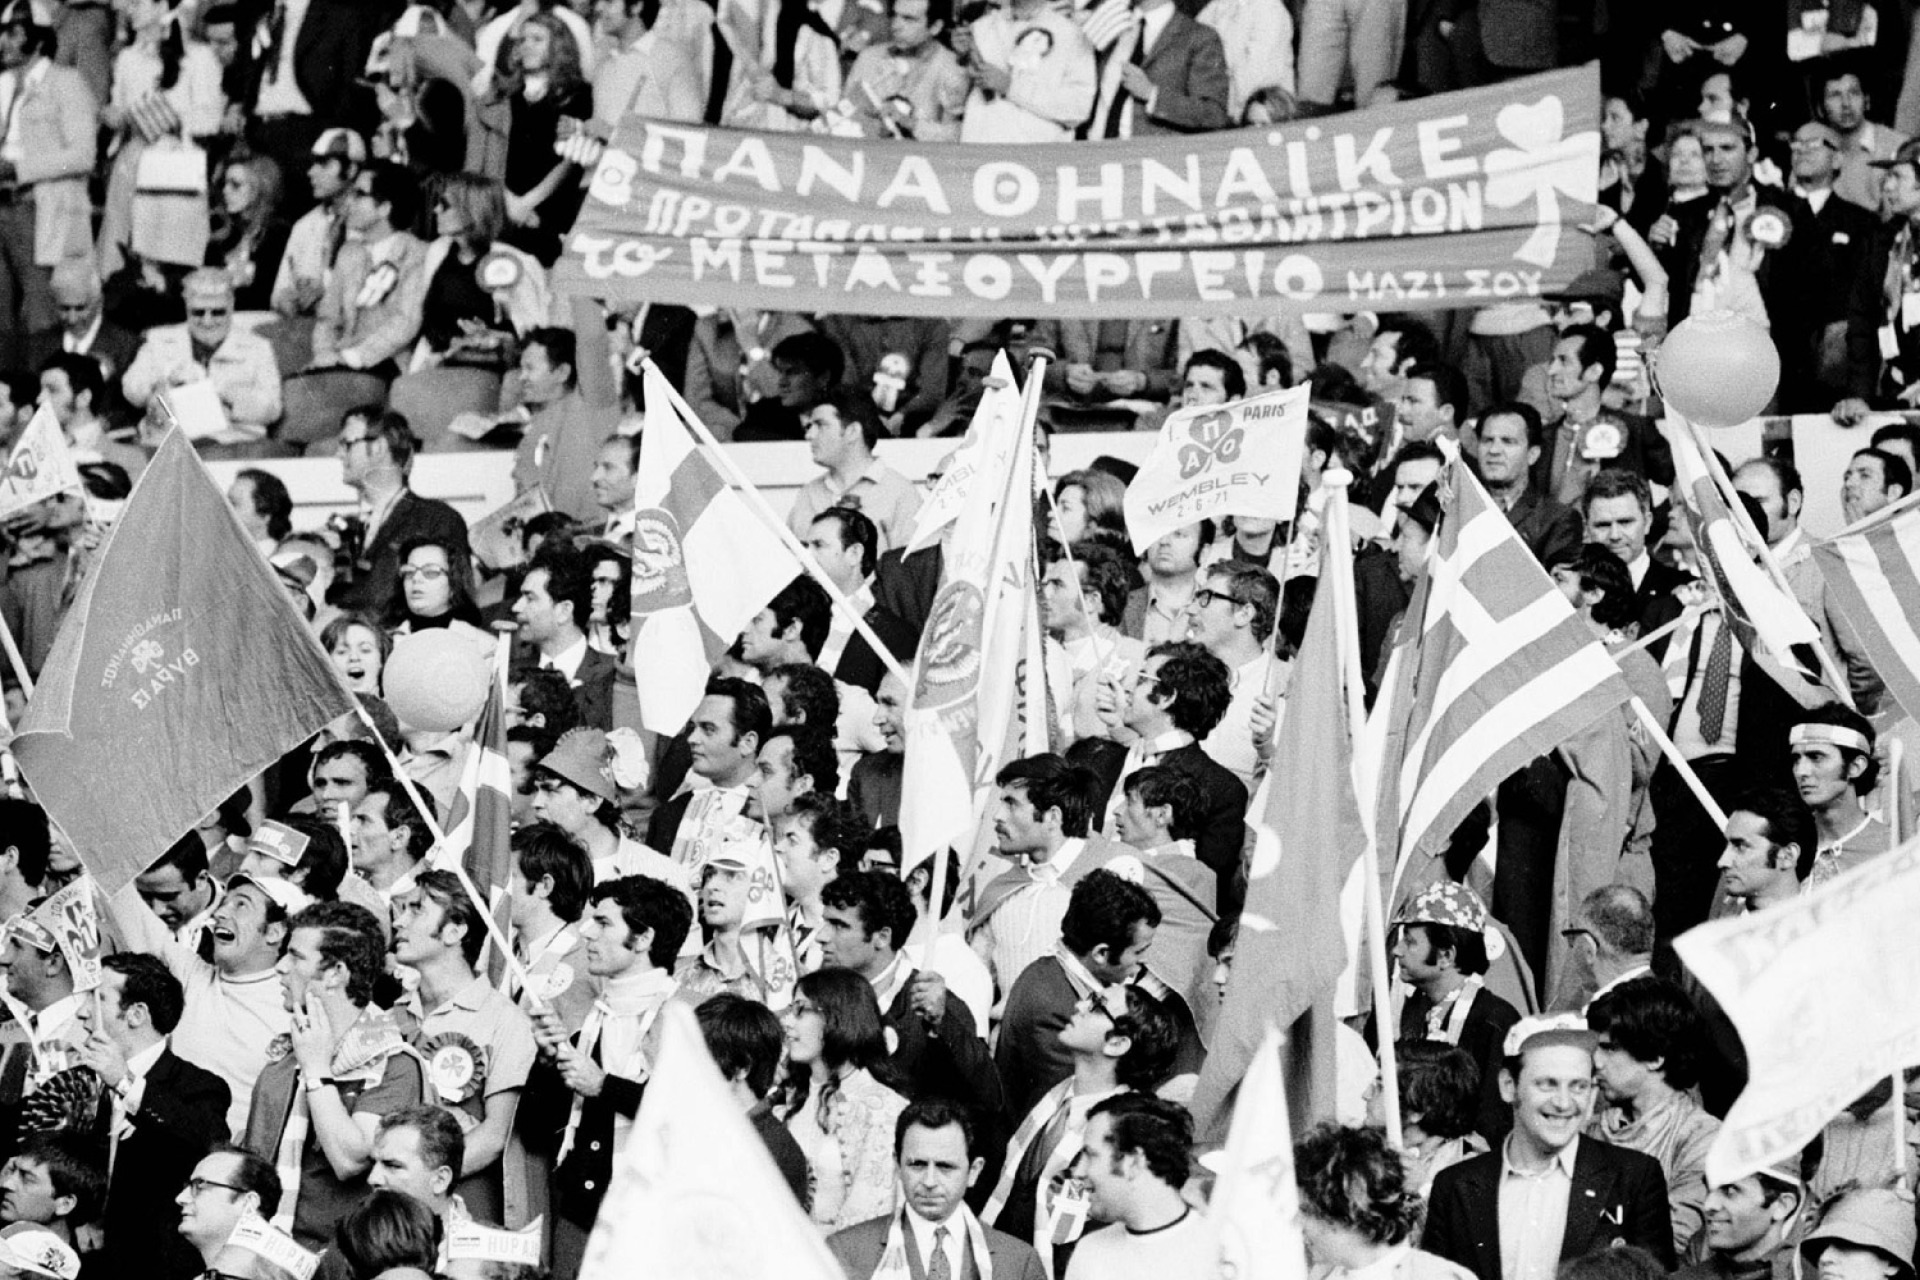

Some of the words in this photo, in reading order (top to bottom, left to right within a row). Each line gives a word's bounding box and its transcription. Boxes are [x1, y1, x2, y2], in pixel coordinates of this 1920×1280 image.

[642, 114, 1479, 223] ΠΑΝΑΘΗΝΑΪΚΕ
[690, 236, 1324, 304] ΜΕΤΑΞΟΥΡΓΕΙΟ
[1347, 270, 1446, 301] ΜΑΖΙ
[1463, 269, 1541, 297] ΣΟΥ
[1243, 402, 1287, 422] PARIS
[1147, 472, 1270, 516] WEMBLEY
